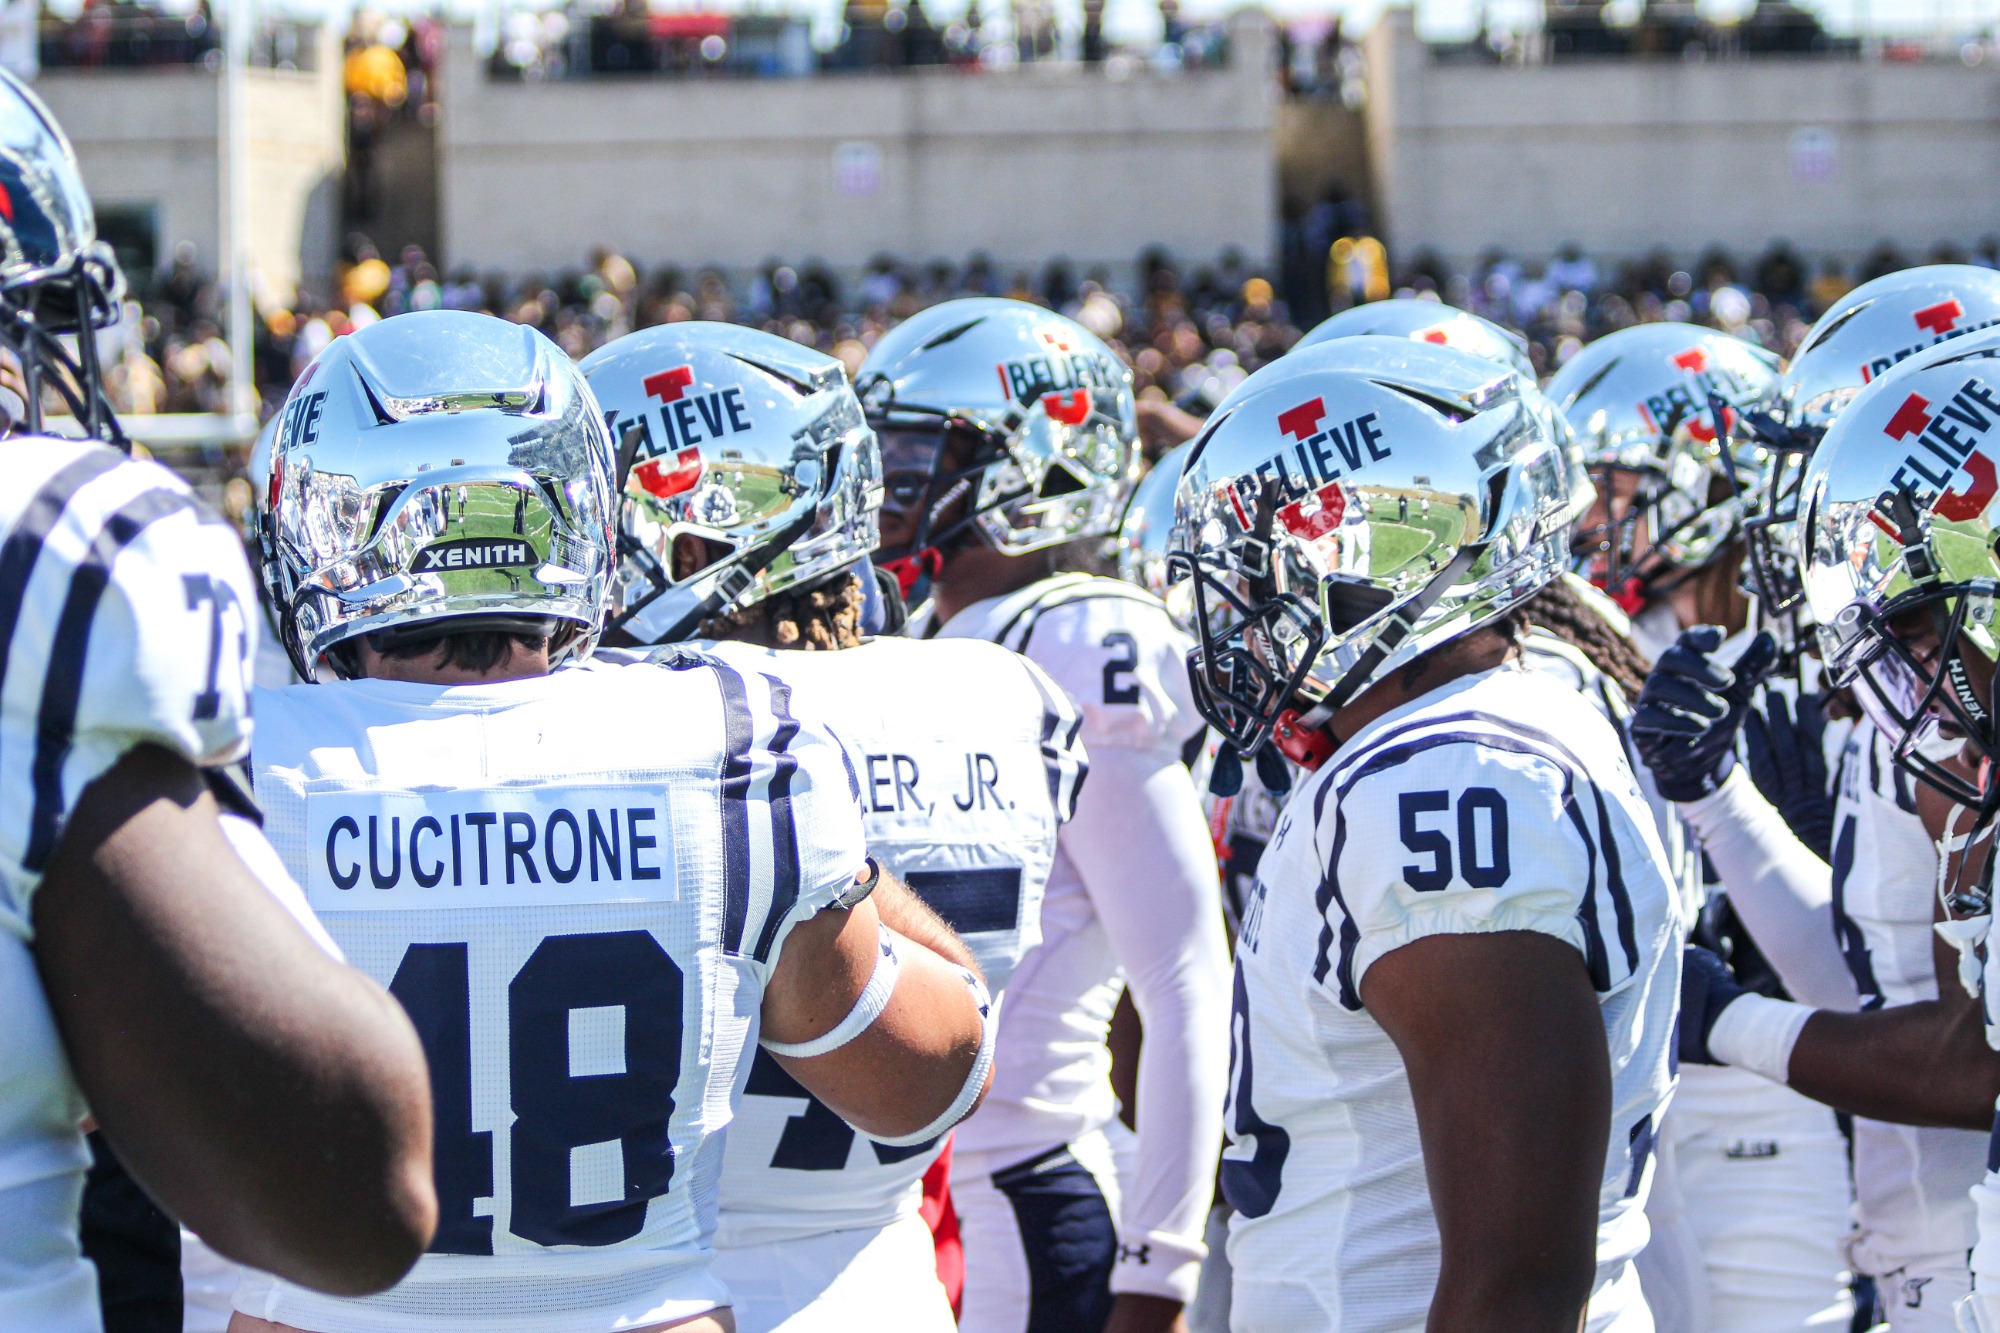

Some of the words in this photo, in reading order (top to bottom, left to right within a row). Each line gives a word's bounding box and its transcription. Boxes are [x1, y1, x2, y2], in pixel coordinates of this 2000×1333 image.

[424, 543, 526, 569] XENITH
[1101, 631, 1141, 704] 2
[1948, 658, 1988, 721] XENITH
[863, 752, 936, 818] ER,
[952, 752, 1016, 812] JR.
[326, 807, 661, 890] CUCITRONE
[1398, 786, 1511, 892] 50
